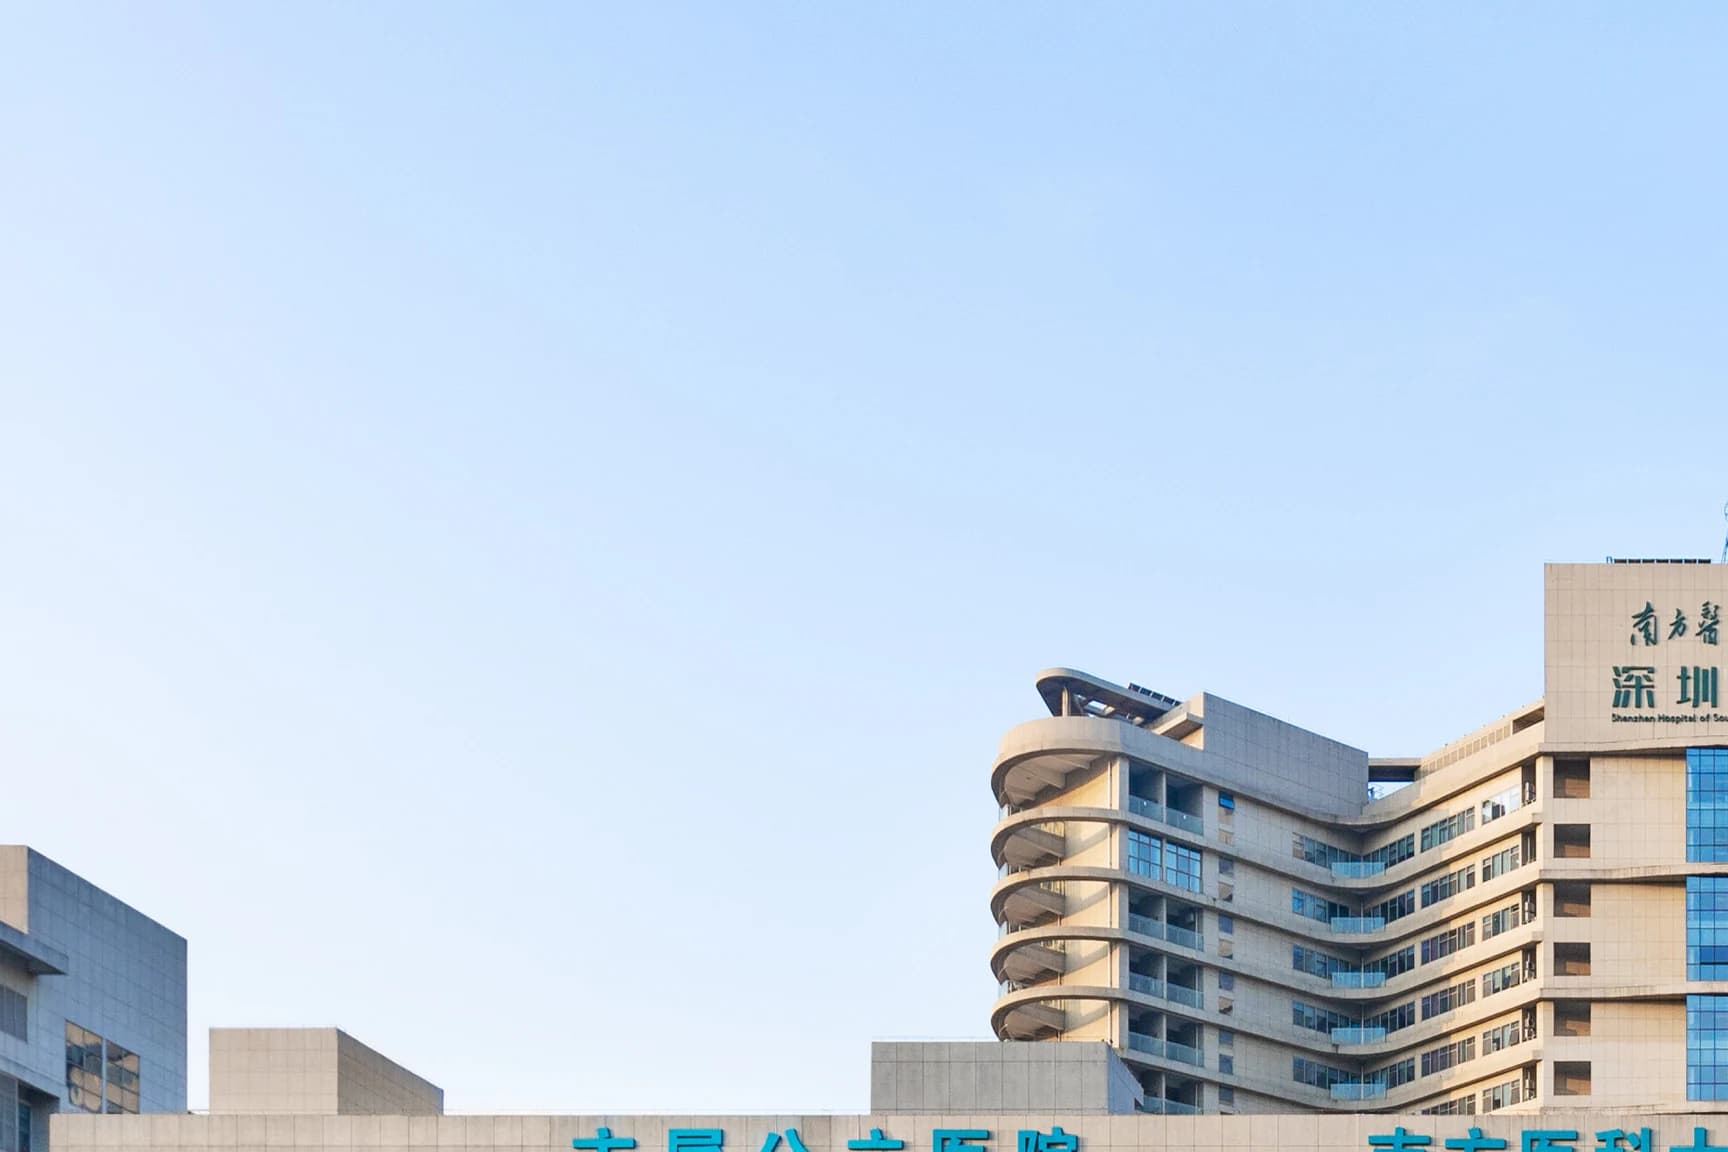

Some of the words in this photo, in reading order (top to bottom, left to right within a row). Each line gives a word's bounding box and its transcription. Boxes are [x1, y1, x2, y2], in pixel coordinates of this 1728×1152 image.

[1611, 713, 1656, 723] Shenzhen
[1657, 713, 1697, 725] Hospital
[1699, 713, 1711, 722] of
